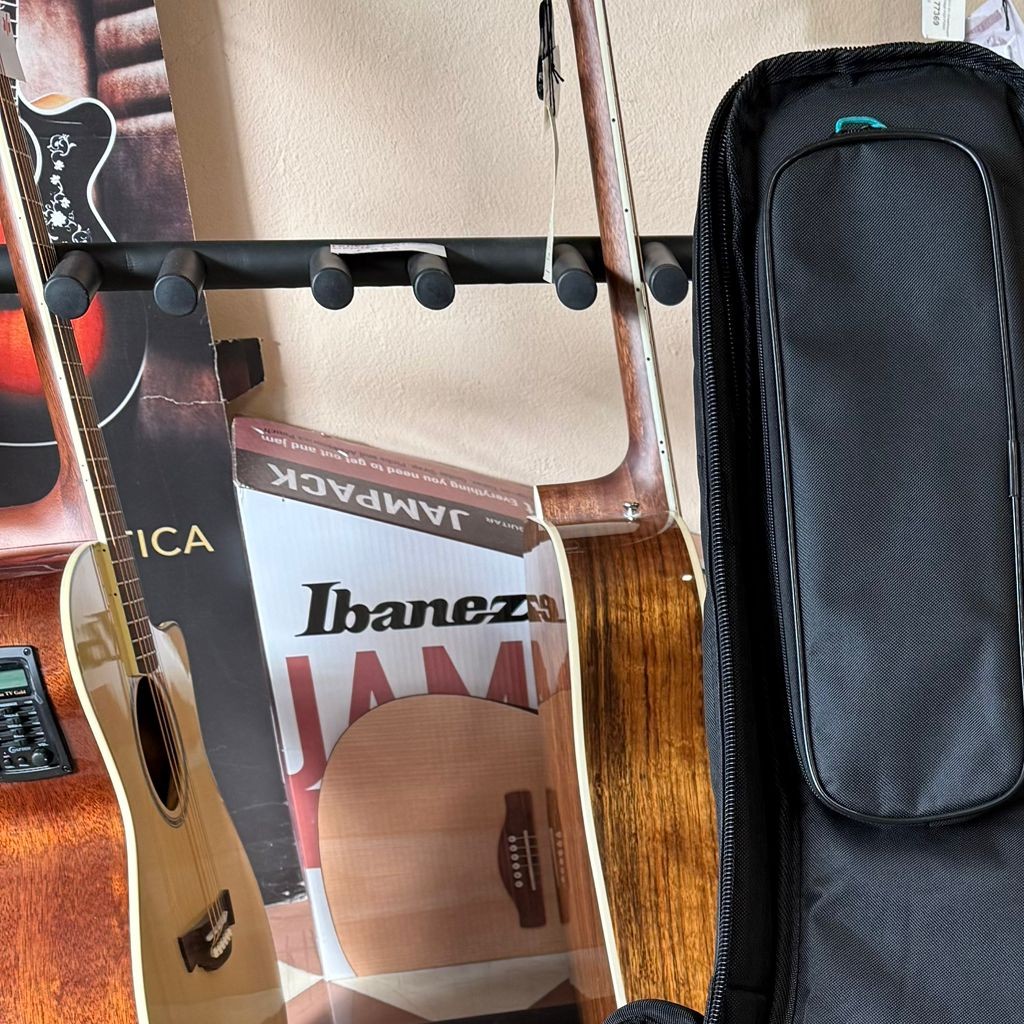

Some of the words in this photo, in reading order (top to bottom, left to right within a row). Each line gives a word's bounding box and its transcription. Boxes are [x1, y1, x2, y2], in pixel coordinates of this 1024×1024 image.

[261, 433, 288, 449] jam
[291, 441, 317, 454] and
[345, 454, 367, 467] get
[370, 462, 384, 474] to
[387, 465, 420, 481] need
[423, 474, 447, 487] you
[267, 463, 470, 531] JAMPACK
[449, 480, 518, 507] Everything
[125, 524, 215, 558] ICA
[294, 581, 530, 637] Ibanez
